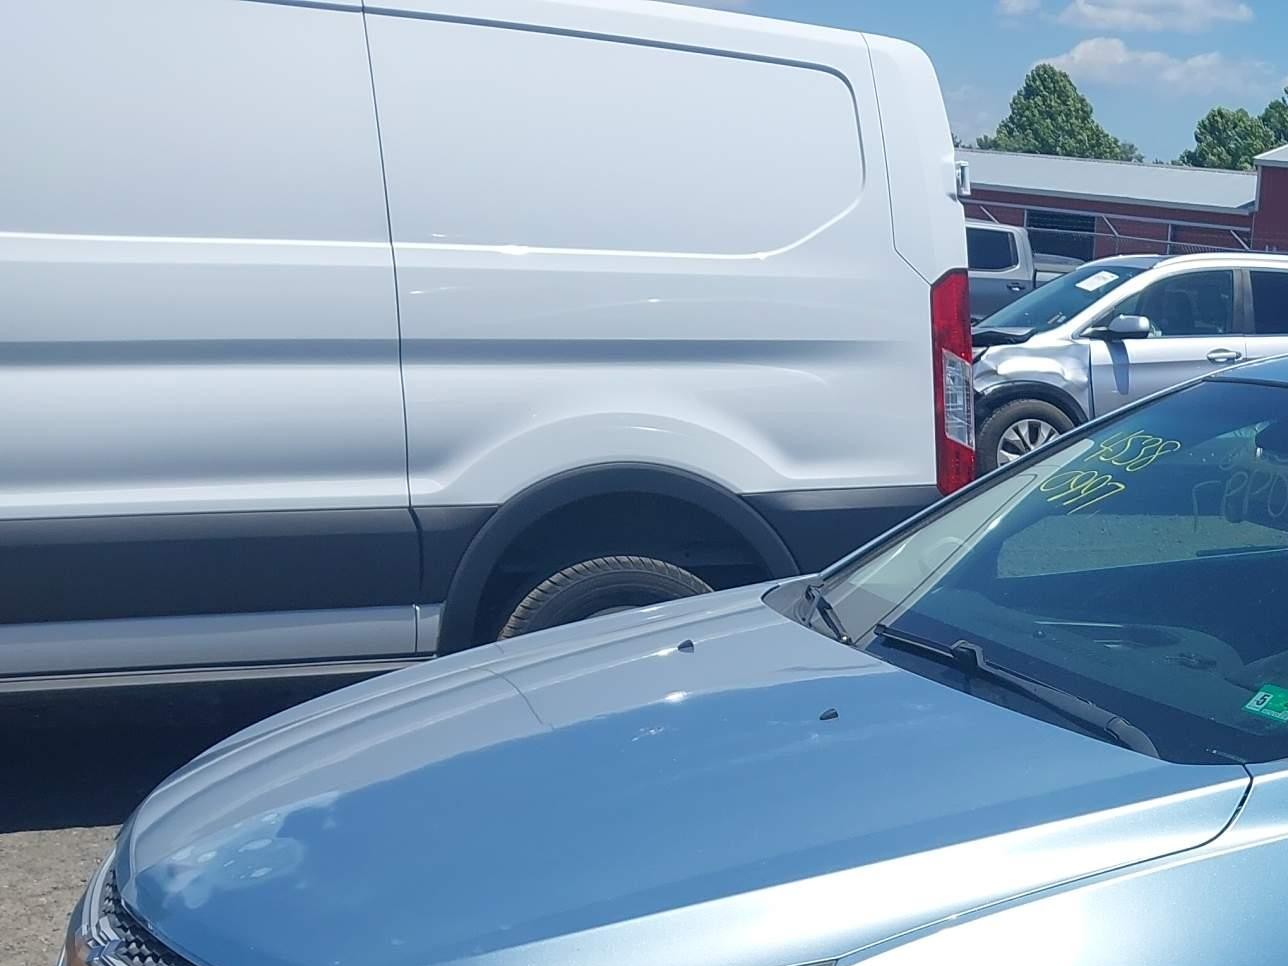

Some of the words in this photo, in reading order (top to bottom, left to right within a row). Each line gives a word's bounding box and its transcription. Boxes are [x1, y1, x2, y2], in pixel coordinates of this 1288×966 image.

[1084, 430, 1181, 472] 4538
[1040, 471, 1126, 515] 0997
[1256, 694, 1271, 706] 5
